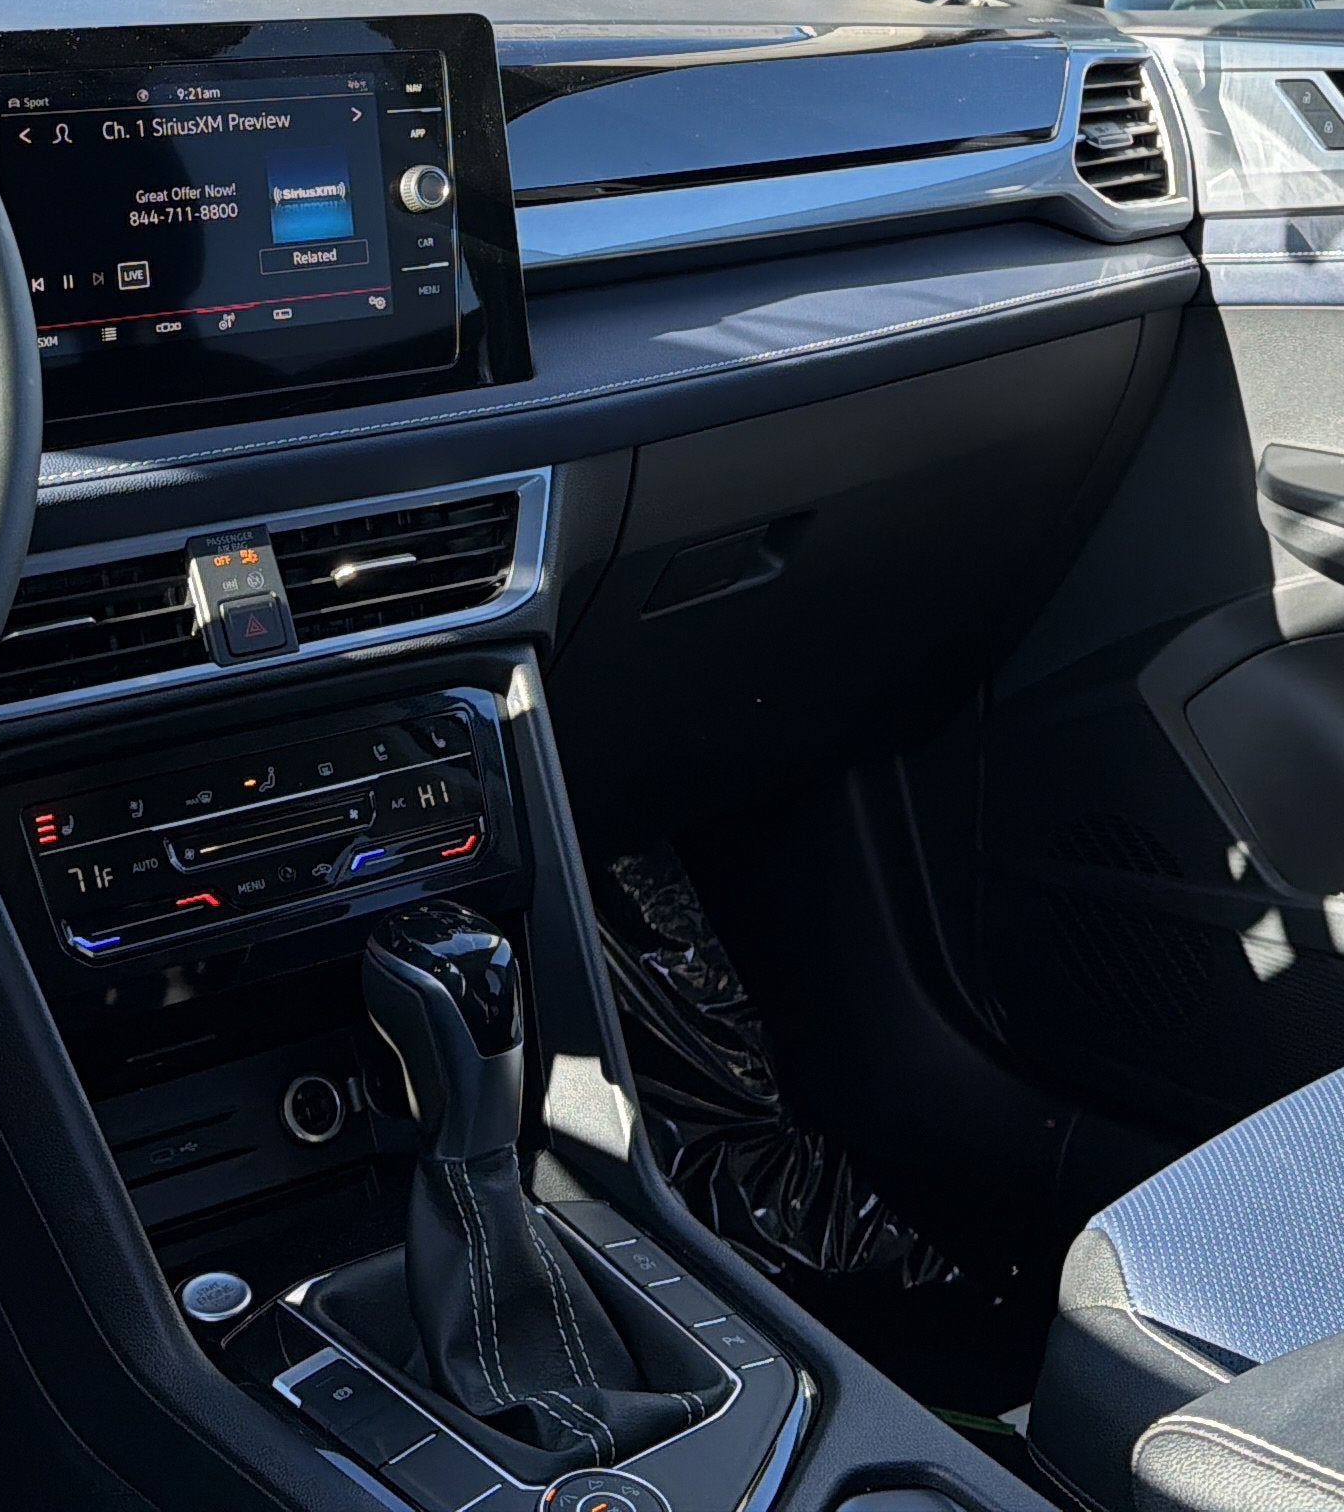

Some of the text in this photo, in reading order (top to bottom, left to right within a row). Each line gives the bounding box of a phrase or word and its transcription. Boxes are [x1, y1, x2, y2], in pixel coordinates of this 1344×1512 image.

[176, 87, 221, 101] 9:21am
[405, 83, 423, 93] NAV
[23, 97, 50, 108] Sport
[102, 111, 291, 140] Ch. 1 SiriusXM Preview
[136, 183, 237, 204] Great Offer Now!
[129, 202, 239, 227] 844-711-8800
[417, 237, 434, 249] CAR
[293, 248, 337, 265] Related
[123, 269, 145, 282] LIVE
[418, 285, 441, 296] MENU
[206, 531, 255, 547] PASSENGER
[212, 555, 233, 567] OFF
[418, 780, 449, 809] HI
[391, 797, 407, 810] A/C
[132, 858, 159, 874] AUTO
[236, 879, 266, 895] MENU
